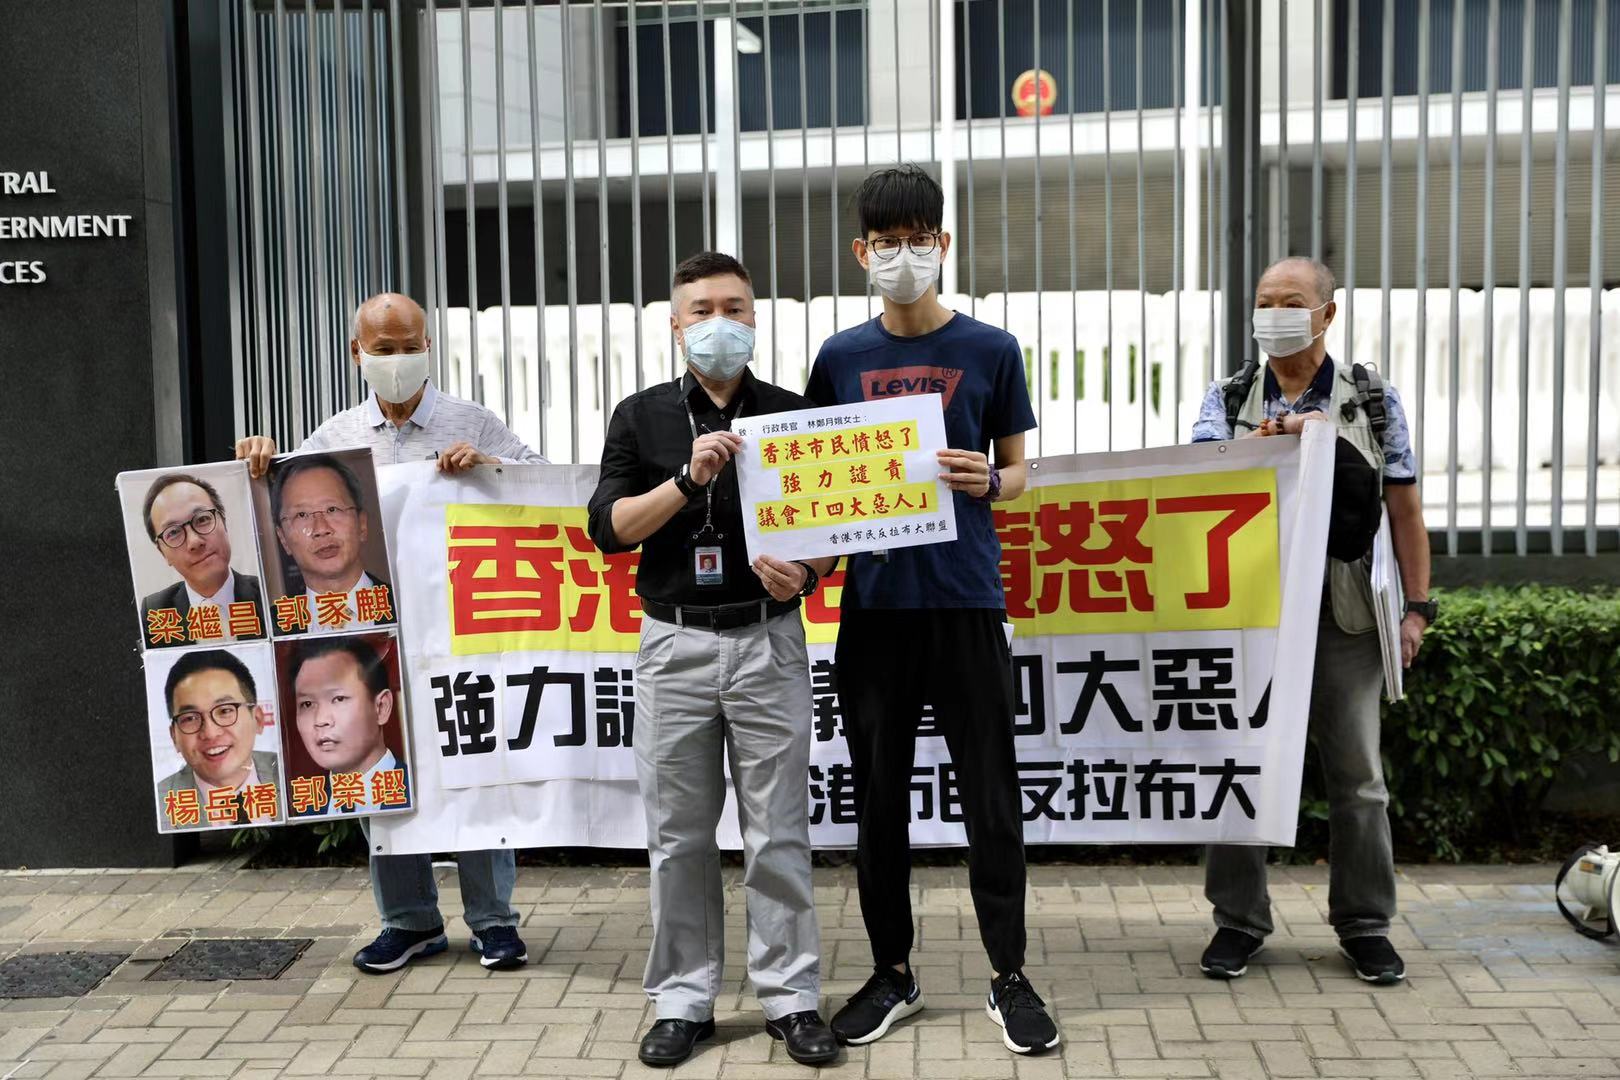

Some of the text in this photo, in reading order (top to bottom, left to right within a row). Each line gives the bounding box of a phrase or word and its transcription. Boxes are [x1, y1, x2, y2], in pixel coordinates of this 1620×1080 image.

[0, 171, 56, 194] RAL
[0, 215, 132, 239] ERNMENT
[0, 261, 47, 284] CES
[763, 427, 912, 464] 香港市民憤怒了
[784, 459, 902, 494] 強力譴責
[829, 519, 948, 544] 香港市民反拉布大聯盟
[147, 601, 261, 643] 梁繼昌
[274, 585, 393, 631] 郭家麒
[164, 783, 277, 825] 楊岳橋
[291, 768, 407, 813] 郭榮鏗
